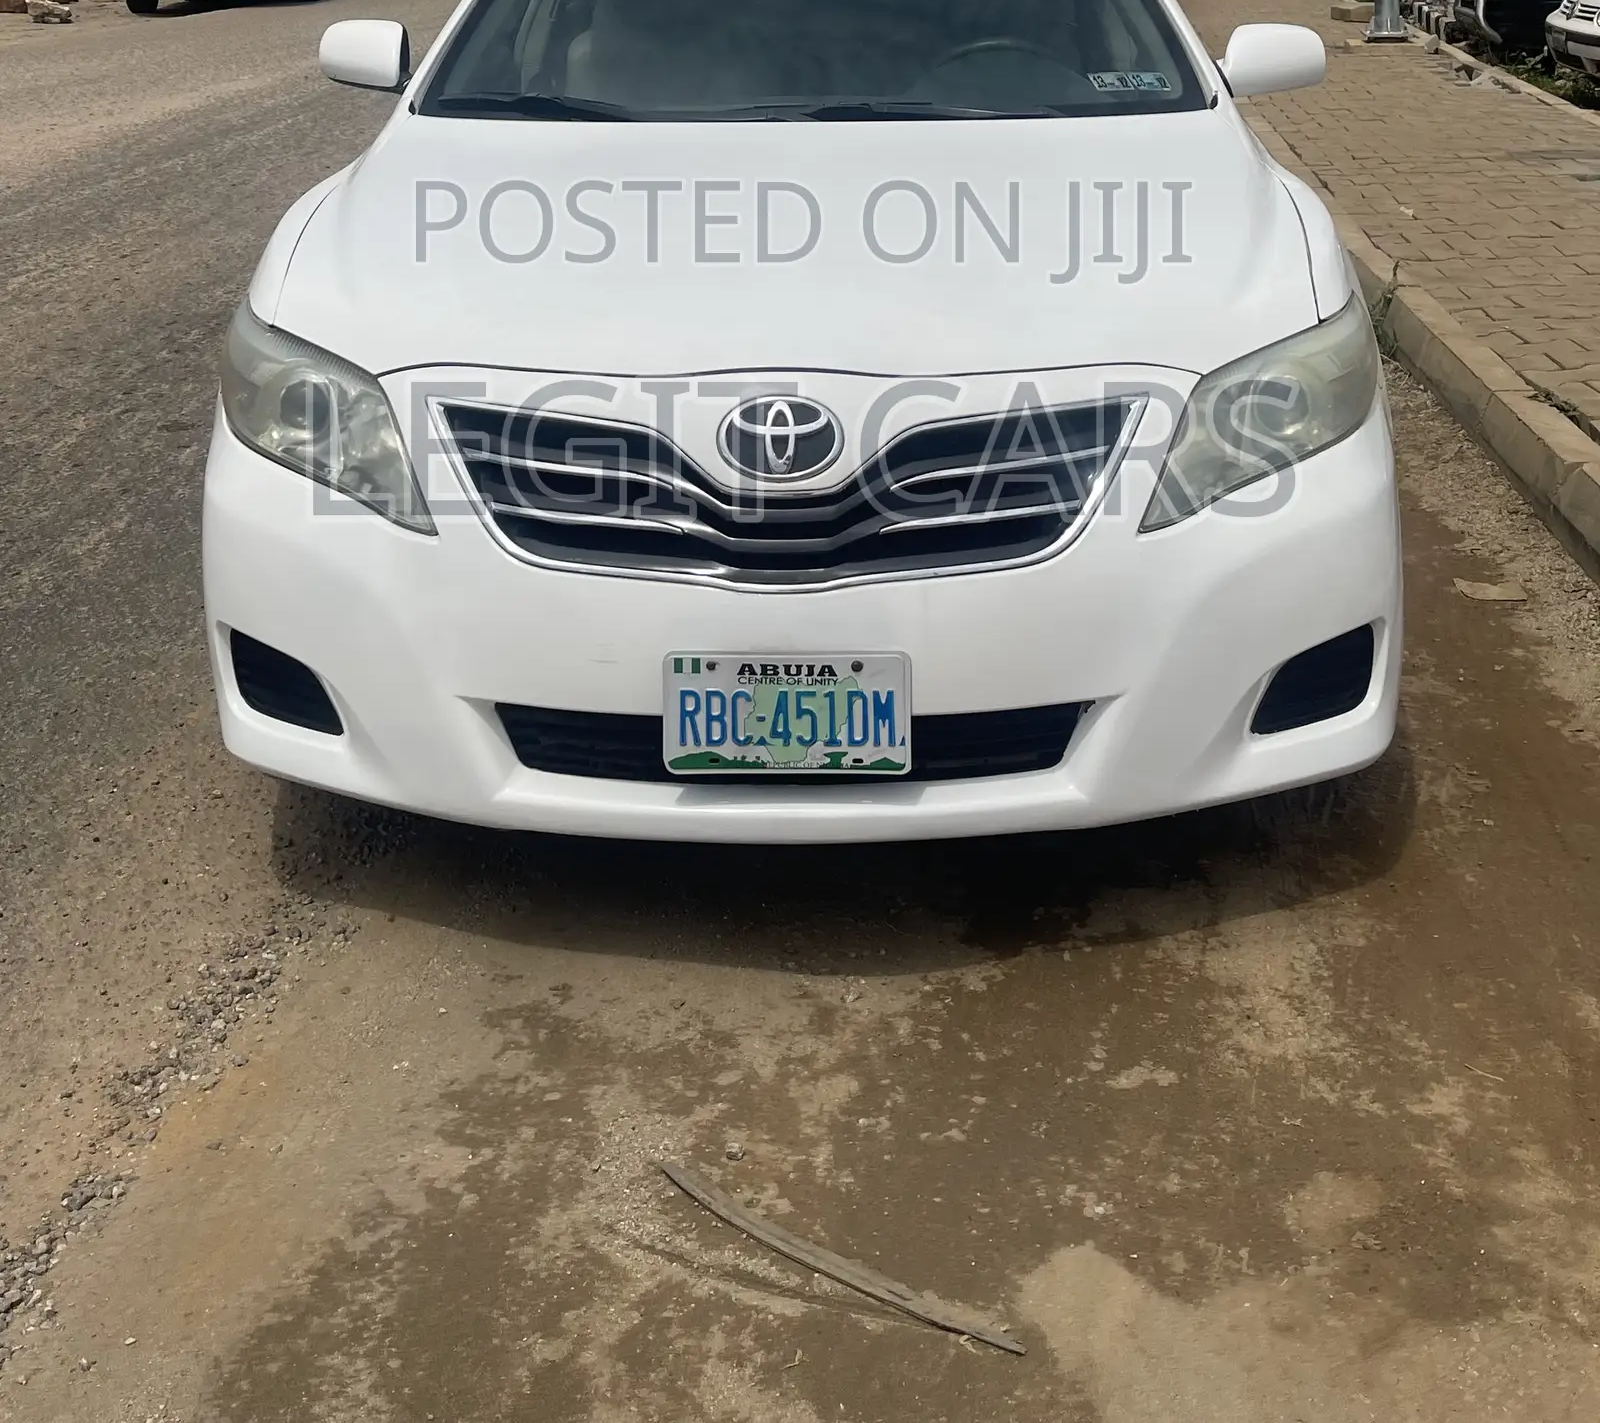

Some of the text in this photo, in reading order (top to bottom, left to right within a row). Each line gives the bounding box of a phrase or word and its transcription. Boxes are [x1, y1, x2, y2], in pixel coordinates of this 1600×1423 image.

[736, 663, 838, 677] ABUJA
[737, 676, 839, 686] CENTRE OF UNITY
